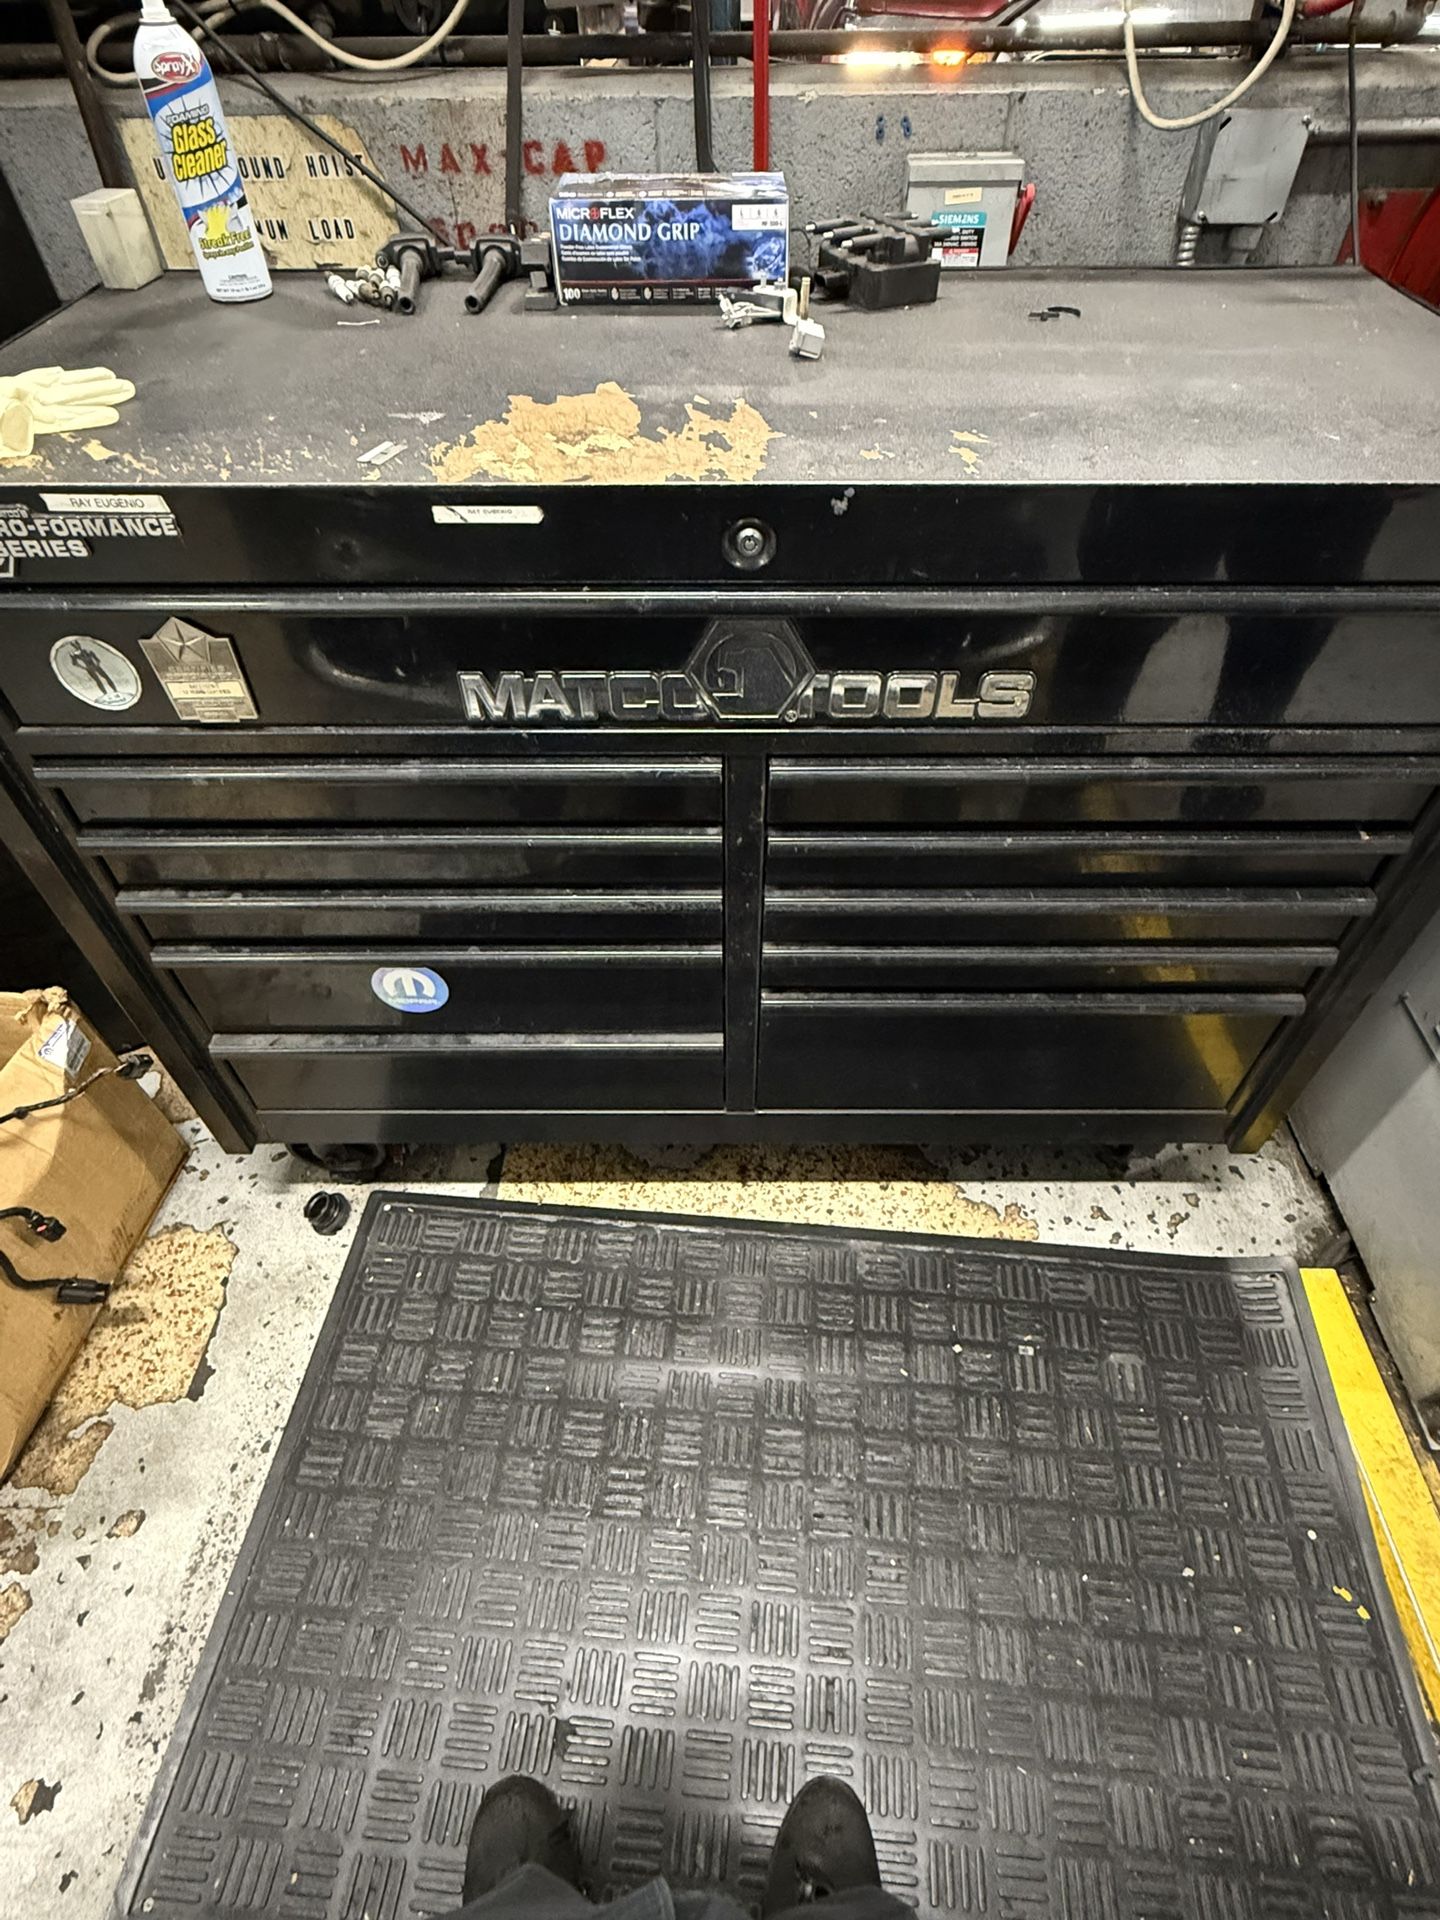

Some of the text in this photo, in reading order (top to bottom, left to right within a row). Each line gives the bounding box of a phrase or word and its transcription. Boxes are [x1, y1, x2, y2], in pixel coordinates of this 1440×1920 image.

[171, 116, 216, 156] Glass
[172, 138, 227, 182] Cleaner
[400, 139, 606, 176] MAX CAP
[555, 206, 636, 220] MICROFLEX
[938, 213, 980, 225] SIEMENS
[308, 218, 355, 241] LOAD
[558, 222, 652, 242] DIAMOND
[656, 222, 701, 242] GRIP
[562, 286, 581, 301] 100
[70, 497, 145, 509] RAY EUGENIO
[0, 517, 179, 537] RO-FORMANCE
[456, 670, 1038, 721] MATCO TOOLS
